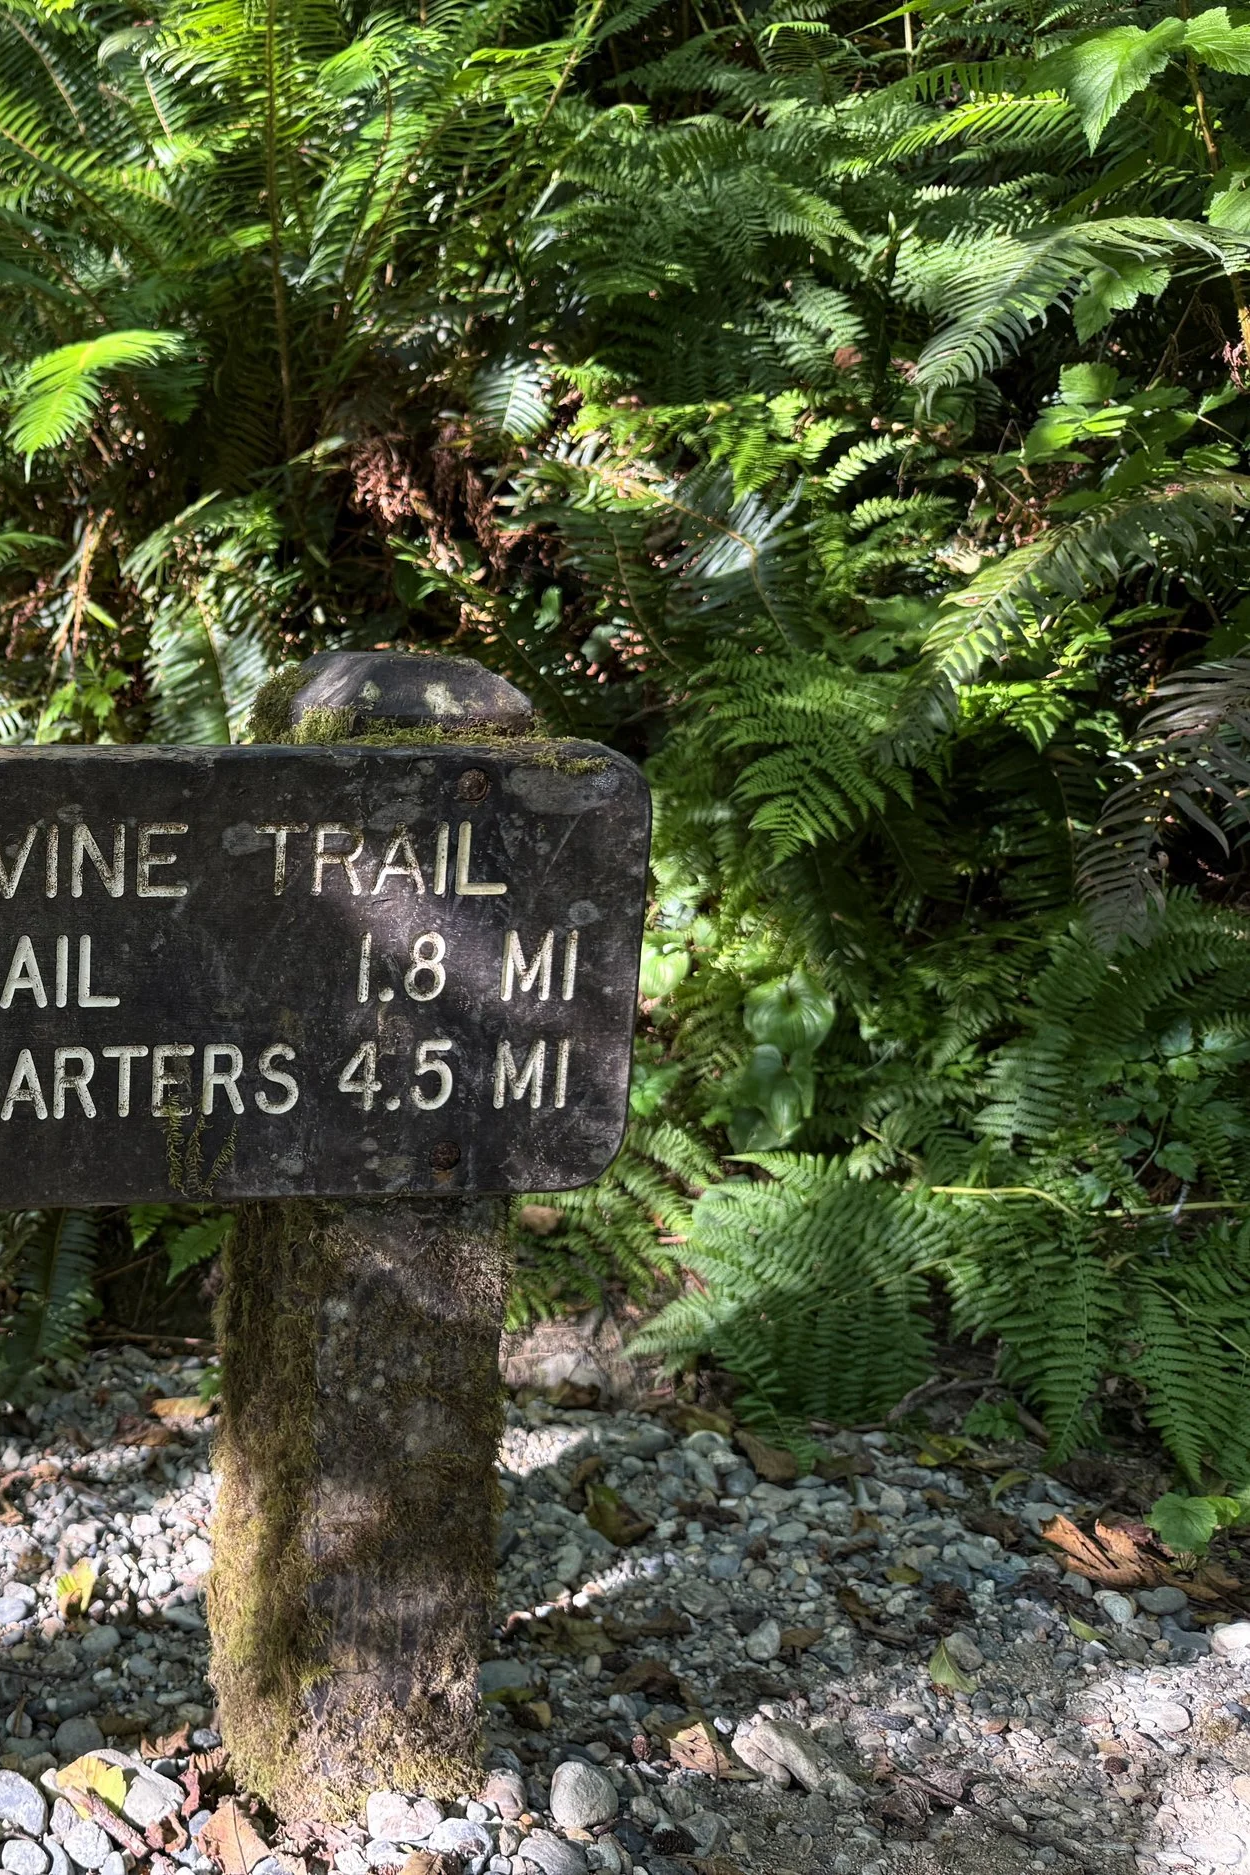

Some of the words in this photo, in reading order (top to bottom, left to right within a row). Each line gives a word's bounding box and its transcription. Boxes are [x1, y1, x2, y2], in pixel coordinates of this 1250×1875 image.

[254, 819, 508, 897] TRAIL
[356, 930, 447, 1004] 1.8
[500, 928, 579, 1003] MI
[337, 1038, 454, 1112] 4.5
[491, 1038, 571, 1110] MI
